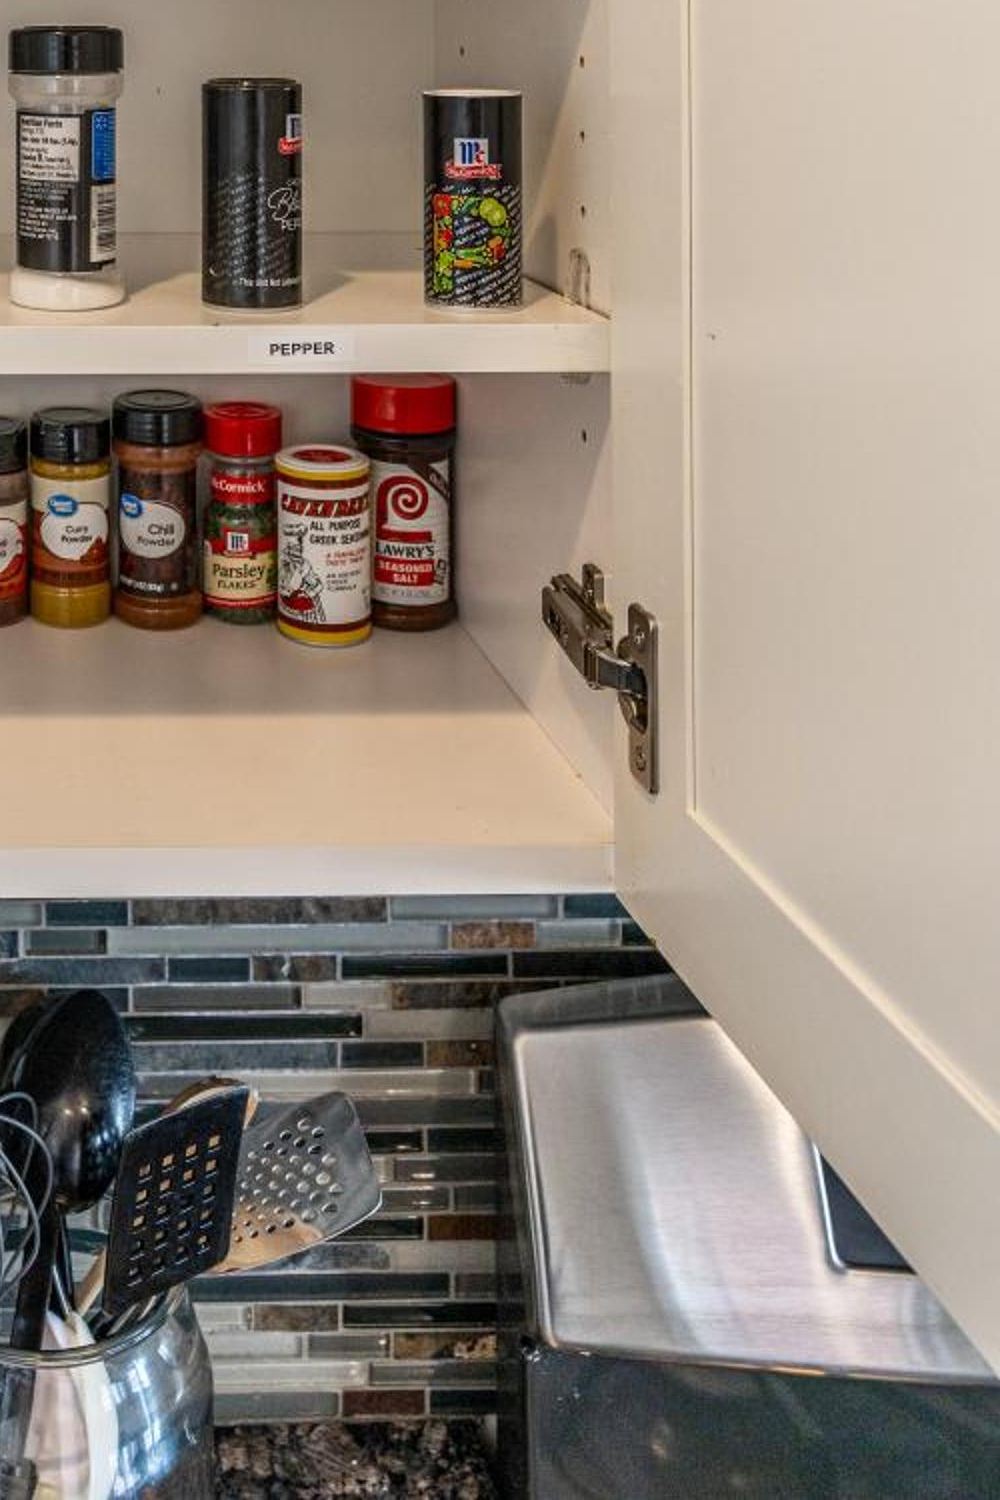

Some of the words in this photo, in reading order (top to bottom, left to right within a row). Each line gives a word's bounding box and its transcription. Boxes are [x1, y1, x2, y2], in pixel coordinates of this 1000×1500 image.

[269, 341, 335, 356] PEPPER
[147, 523, 175, 536] Chili
[310, 520, 325, 531] ALL
[61, 535, 93, 544] Powder
[136, 536, 175, 547] Powder
[376, 542, 435, 558] LAWRY'S
[212, 563, 266, 580] Parsley
[379, 560, 433, 573] SEASONED
[391, 573, 419, 584] SALT
[217, 580, 258, 590] FLAKES
